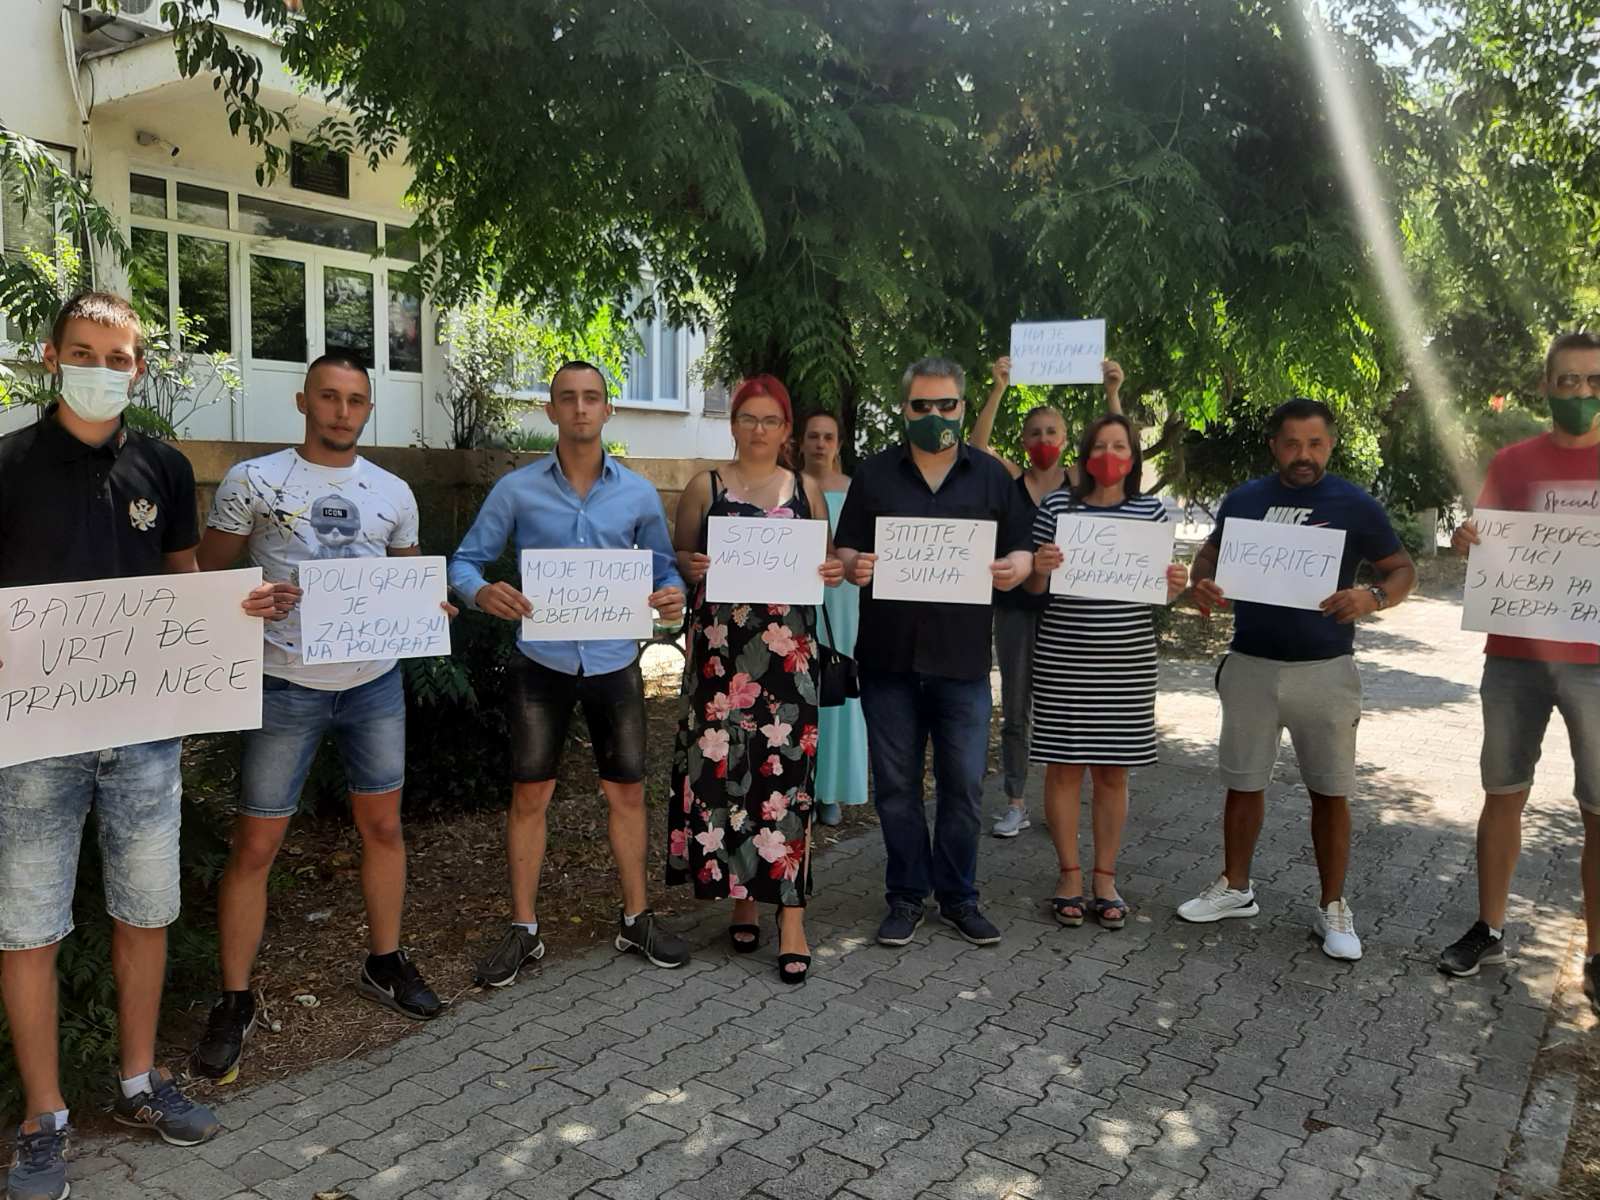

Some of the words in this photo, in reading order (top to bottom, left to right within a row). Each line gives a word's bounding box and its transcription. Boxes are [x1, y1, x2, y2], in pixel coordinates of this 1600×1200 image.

[324, 508, 344, 517] ICON
[1263, 506, 1313, 526] NIKE
[721, 525, 793, 545] STOP
[1068, 521, 1118, 547] NE
[1068, 547, 1150, 568] TUČITE
[1221, 539, 1337, 577] INTEGRITET
[304, 566, 439, 595] POLIGRAF
[896, 567, 963, 584] SVIMA
[1472, 569, 1487, 589] S
[1495, 571, 1554, 592] NEBA
[1567, 576, 1592, 596] PA
[340, 597, 369, 615] JE
[547, 585, 609, 605] МОЈА
[9, 588, 177, 632] BATINA
[531, 606, 634, 625] СВЕТИЊА
[315, 618, 410, 643] ZAKON
[415, 615, 446, 636] SVI
[41, 627, 134, 676] VRTI
[306, 644, 333, 662] NA
[346, 635, 441, 658] POLIGRAF
[0, 670, 137, 722] PRAVDA
